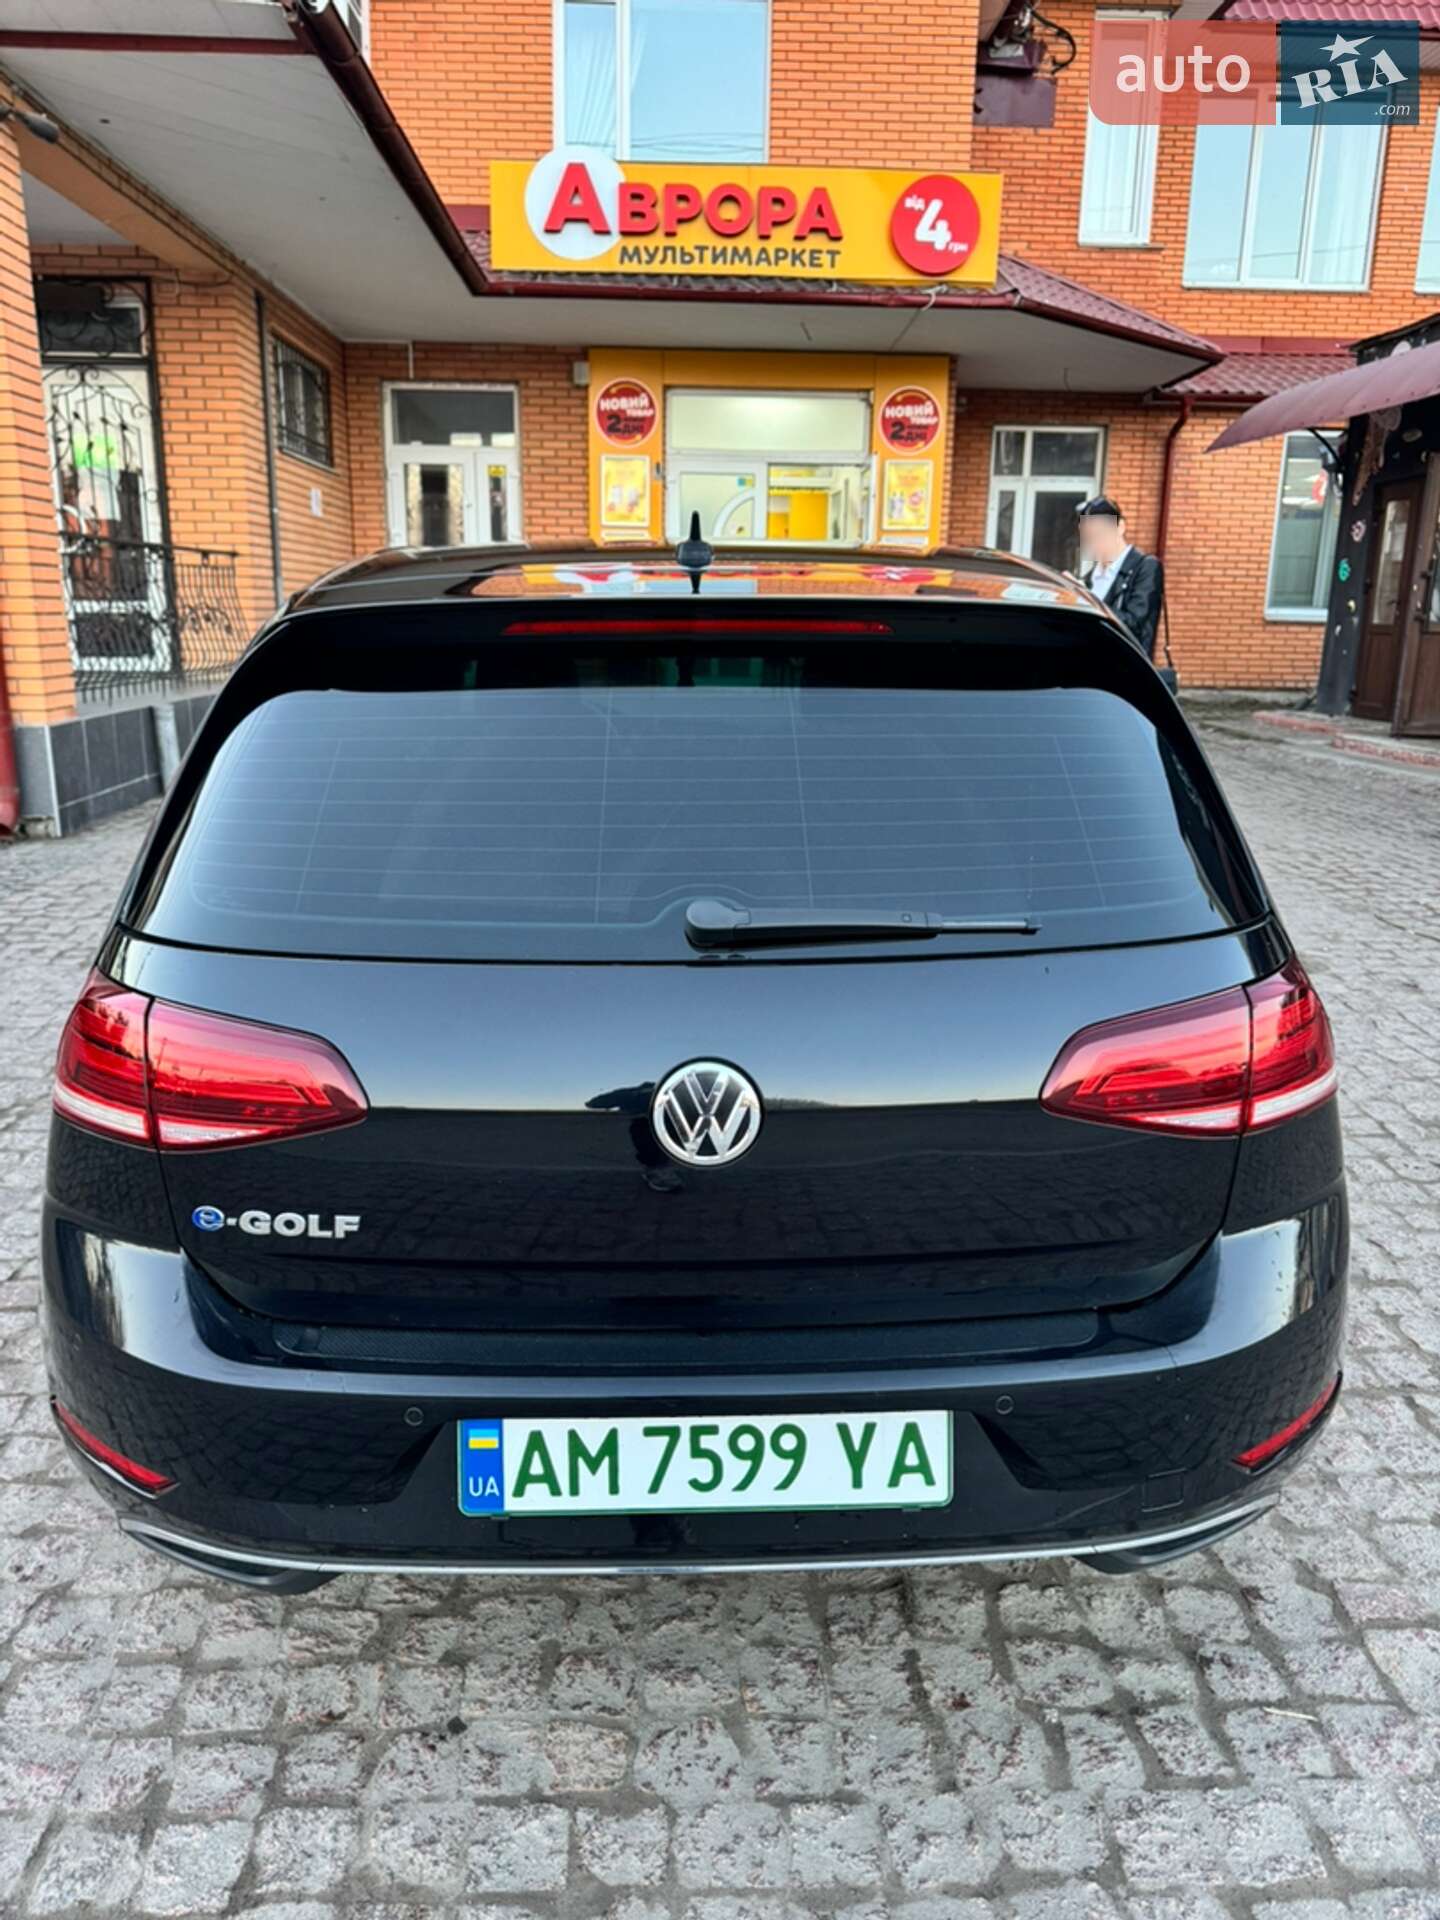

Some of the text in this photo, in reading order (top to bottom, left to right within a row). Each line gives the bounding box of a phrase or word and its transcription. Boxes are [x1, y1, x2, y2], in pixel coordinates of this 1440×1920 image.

[914, 198, 952, 250] 4
[618, 244, 842, 269] МУЛЬТИМАРКЕТ
[606, 415, 622, 433] 2
[890, 421, 905, 440] 2
[191, 1205, 361, 1239] e-GOLF
[511, 1421, 937, 1498] AM 7599 YA
[469, 1476, 500, 1497] UA
